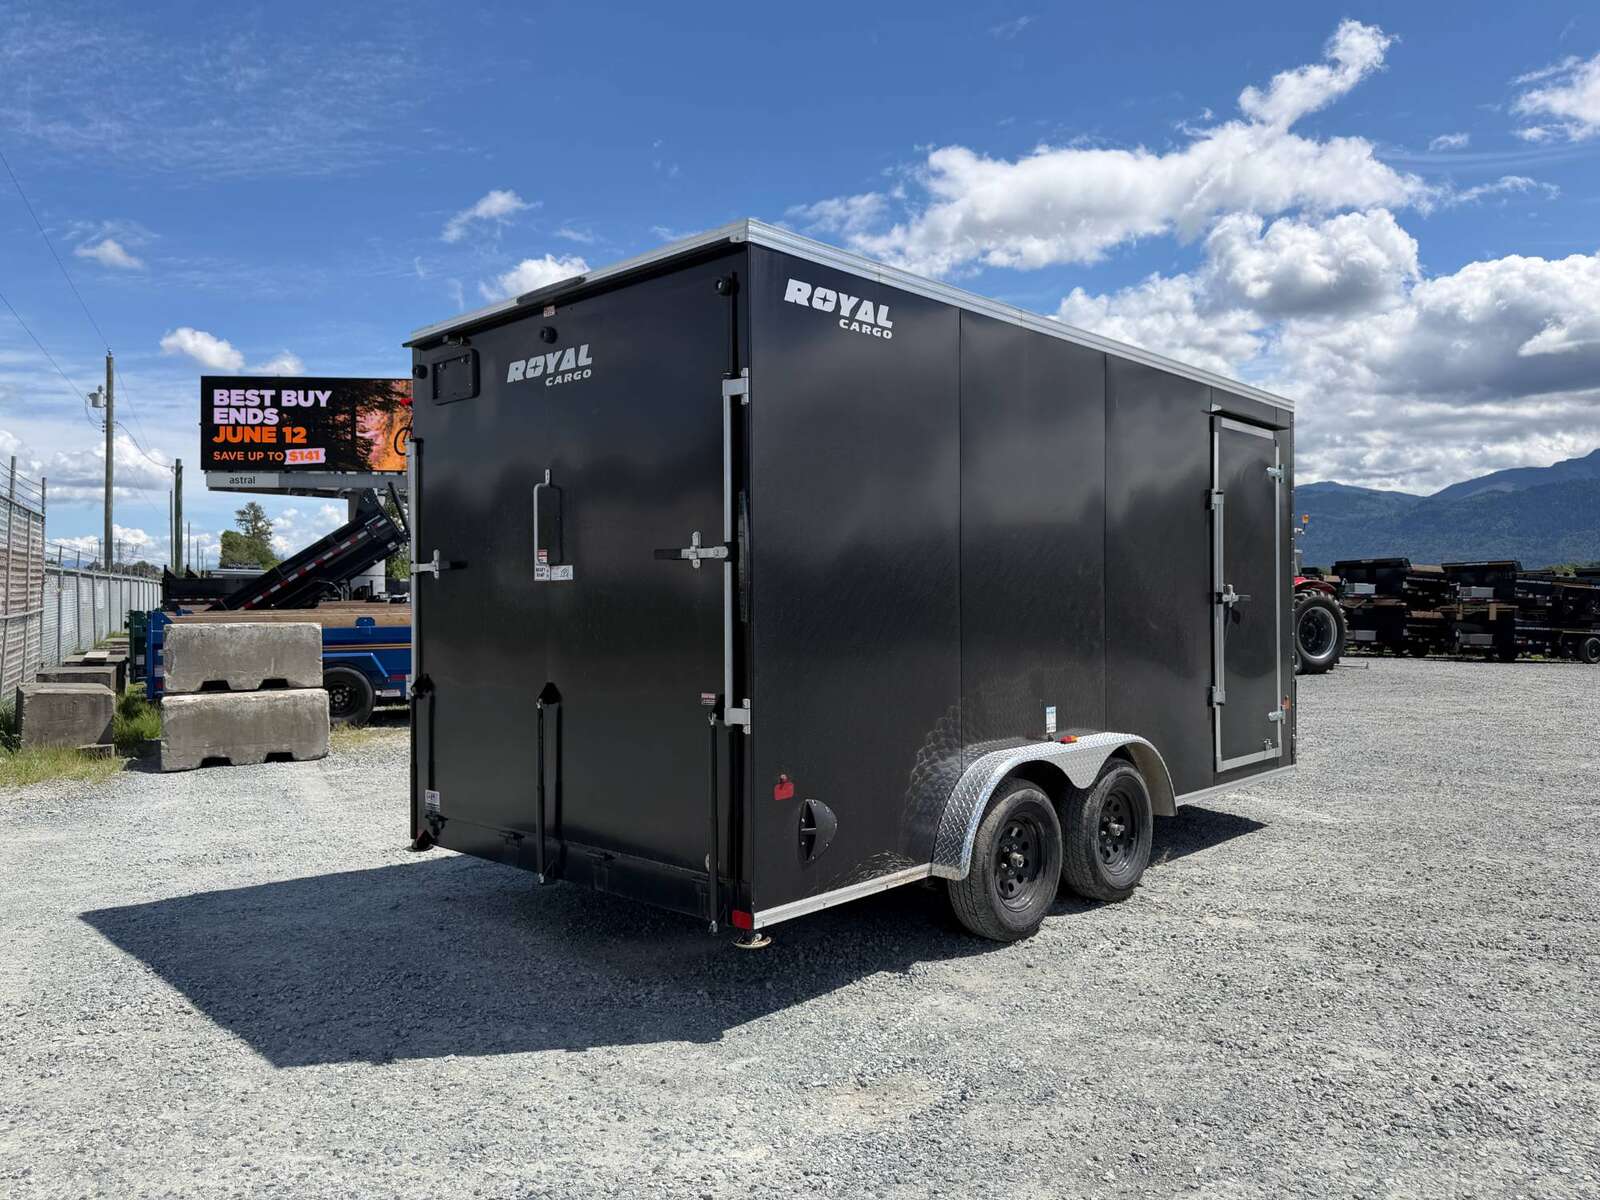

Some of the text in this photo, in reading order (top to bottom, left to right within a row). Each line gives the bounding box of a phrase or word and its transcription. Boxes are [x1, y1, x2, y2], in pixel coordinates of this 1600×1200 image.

[784, 278, 893, 329] ROYAL
[839, 318, 893, 339] CARGO
[507, 343, 593, 383] ROYAL
[545, 369, 592, 386] CARGO
[213, 389, 332, 407] BEST BUY
[213, 407, 279, 425] ENDS
[212, 426, 307, 443] JUNE 12
[213, 449, 321, 462] SAVE UP TO $141
[229, 475, 256, 485] astral
